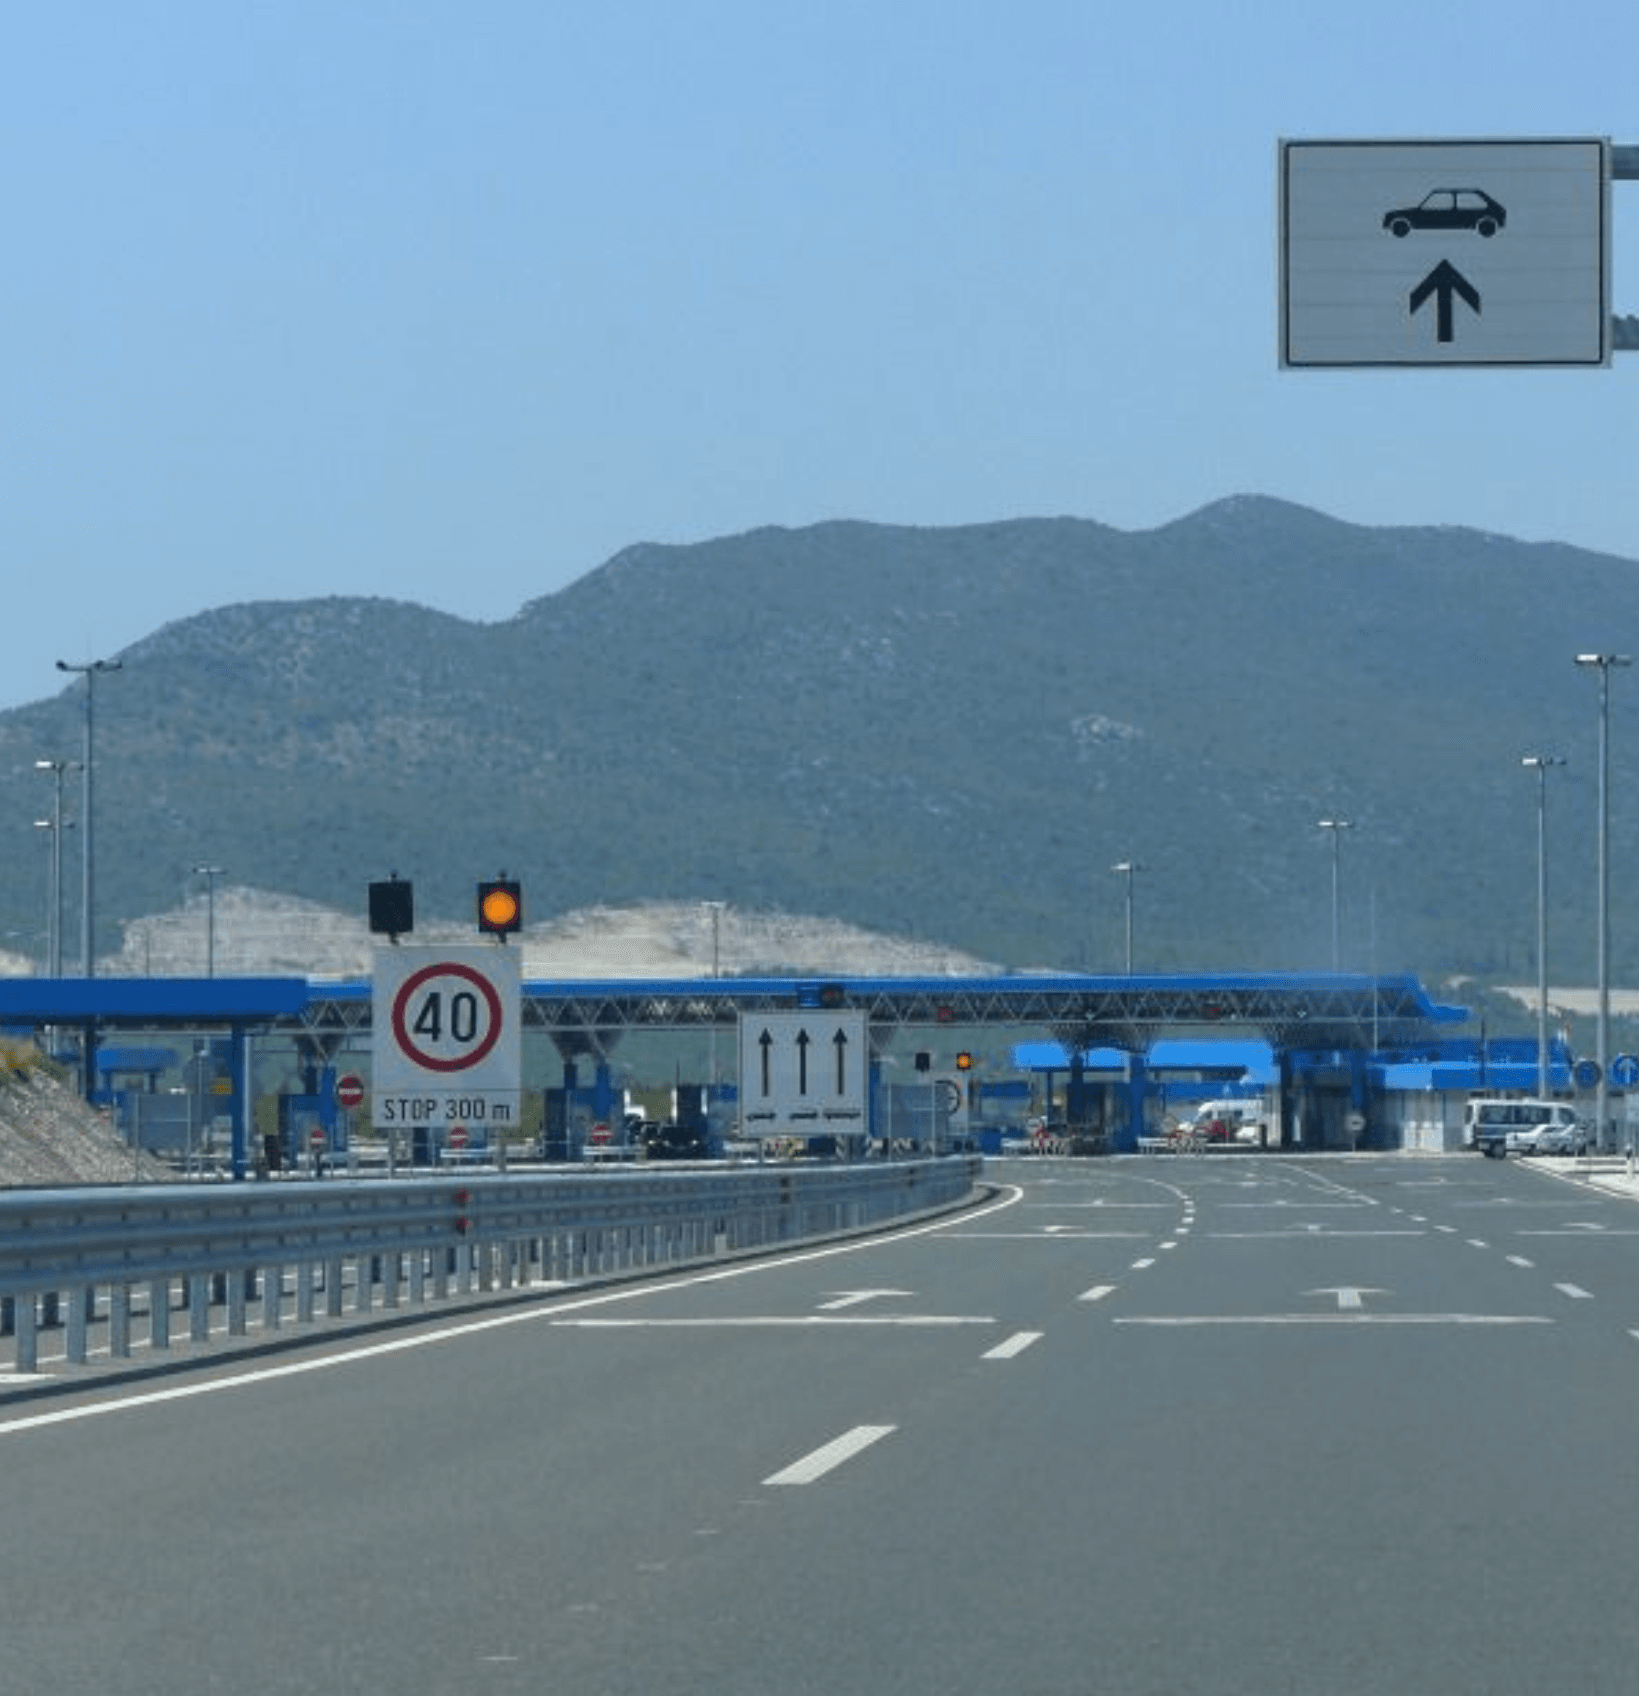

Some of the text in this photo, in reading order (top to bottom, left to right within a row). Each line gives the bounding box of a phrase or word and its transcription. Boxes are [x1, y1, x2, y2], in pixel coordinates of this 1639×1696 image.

[413, 992, 477, 1042] 40
[384, 1098, 510, 1120] STOP 300 m
